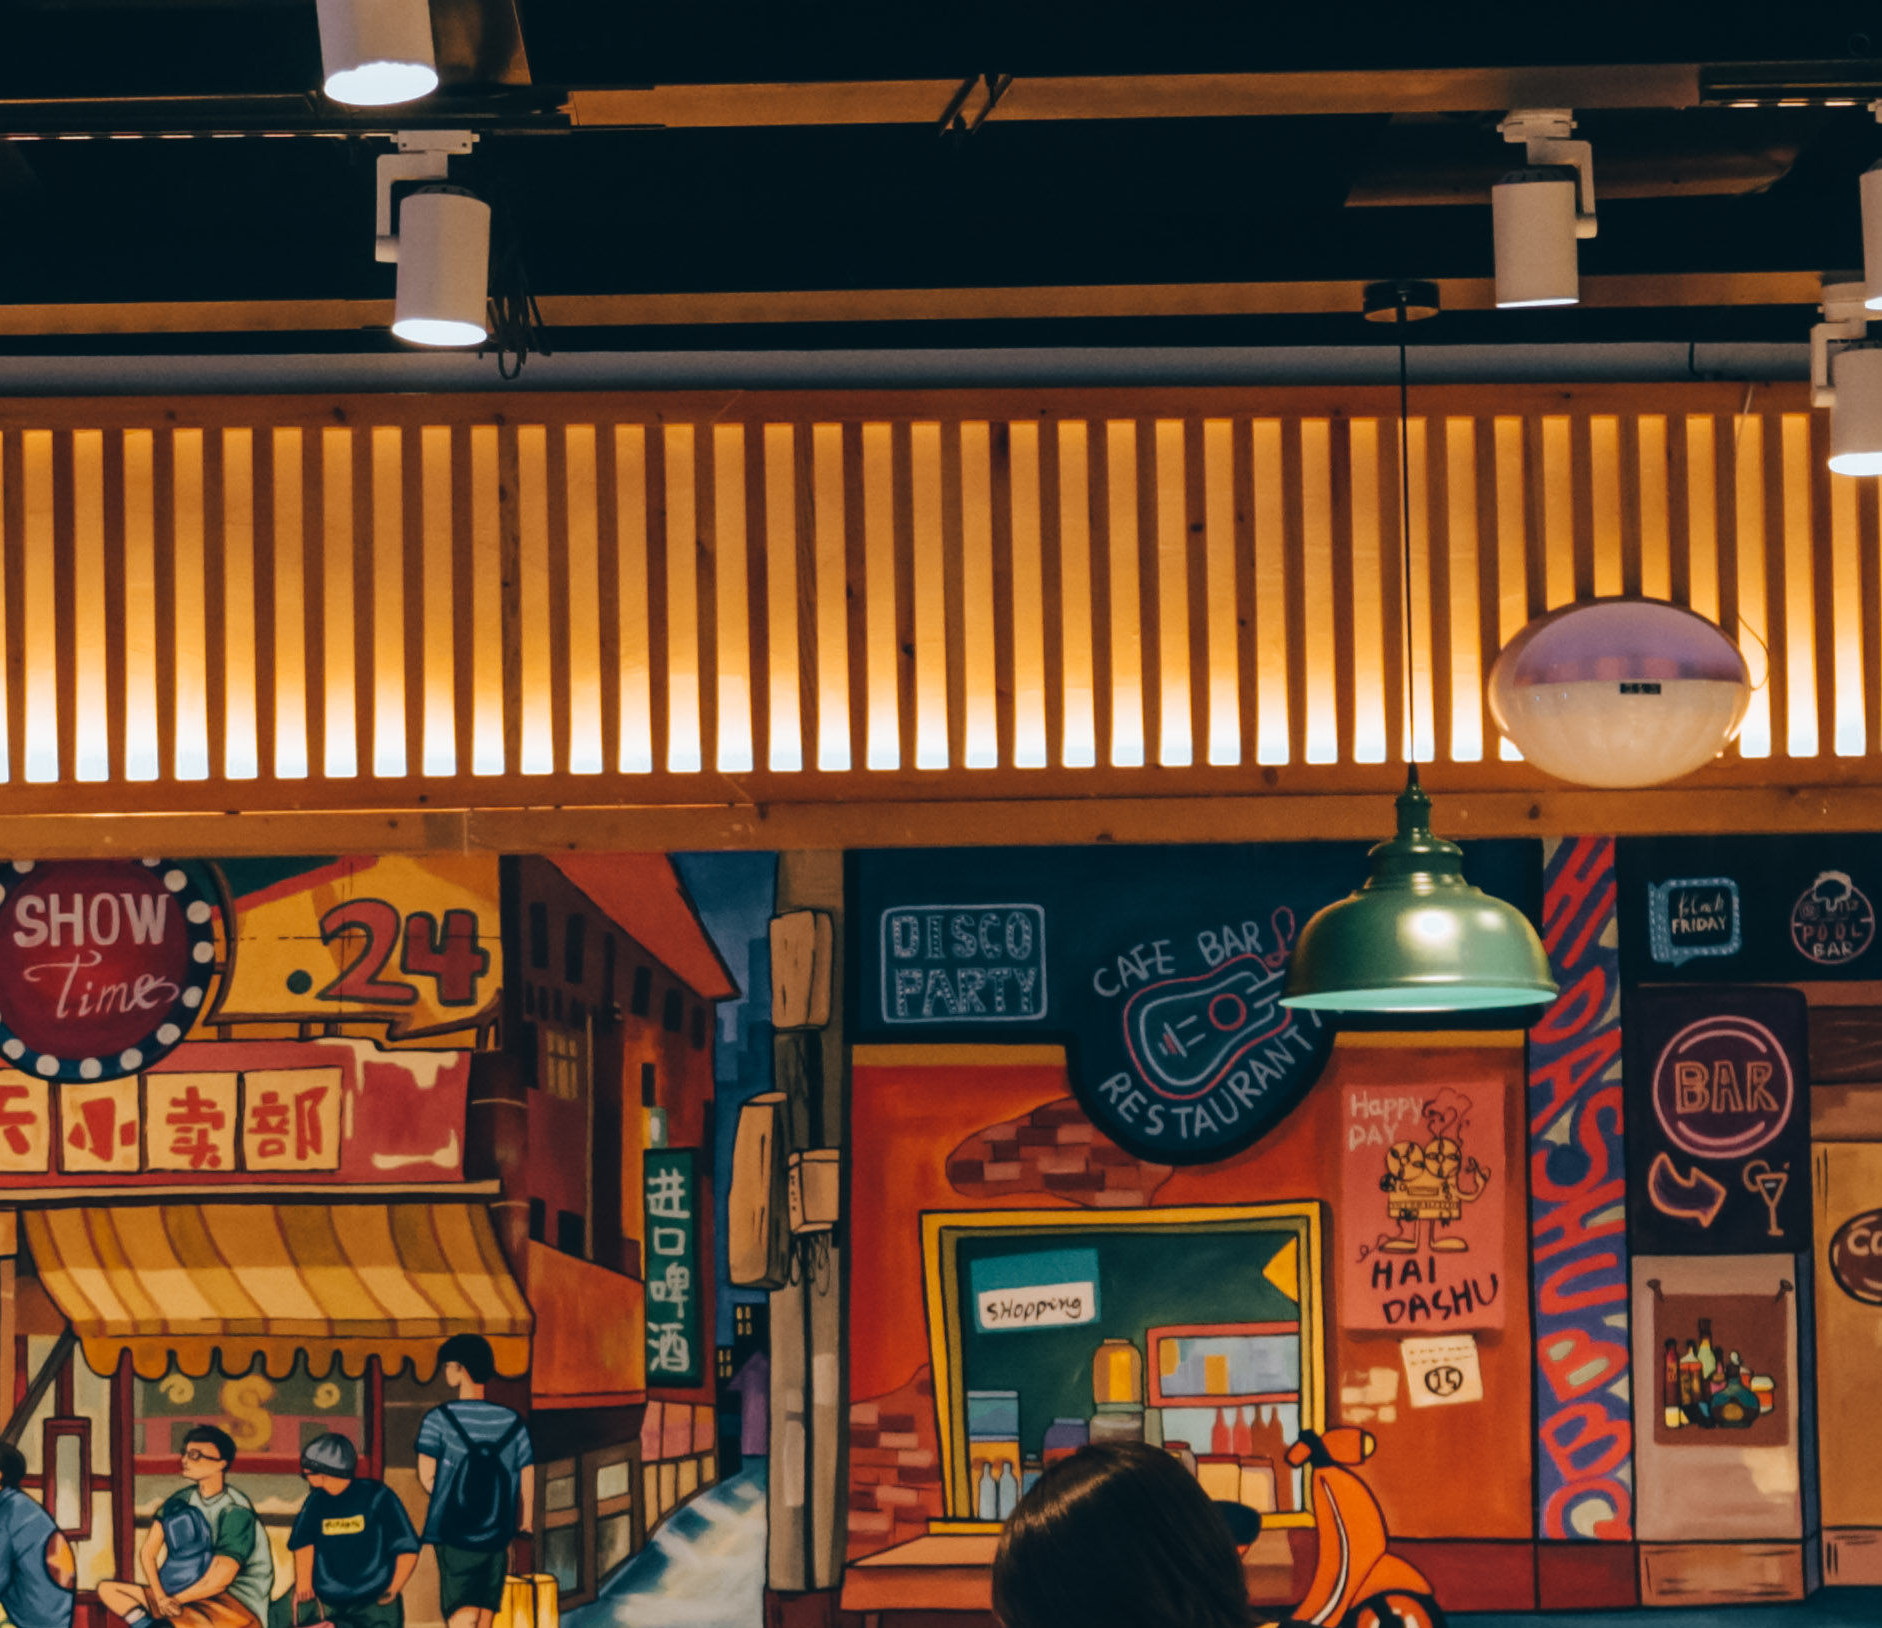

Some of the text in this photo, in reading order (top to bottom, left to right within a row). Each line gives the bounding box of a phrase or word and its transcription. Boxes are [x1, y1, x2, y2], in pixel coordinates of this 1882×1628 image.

[13, 892, 170, 950] SHOW
[891, 912, 1033, 960] DISCO
[1671, 916, 1727, 934] FRIDAY
[23, 951, 180, 1018] Time
[1093, 920, 1260, 998] CAFE BAR
[894, 966, 1039, 1017] PARTY
[1098, 1024, 1314, 1140] RESTAURANT
[1350, 1089, 1424, 1125] Happy
[1673, 1060, 1780, 1115] BAR
[1349, 1122, 1399, 1152] DAY
[646, 1167, 691, 1374] 进口啤酒
[1372, 1256, 1437, 1290] HAI
[1383, 1273, 1499, 1325] DASHU
